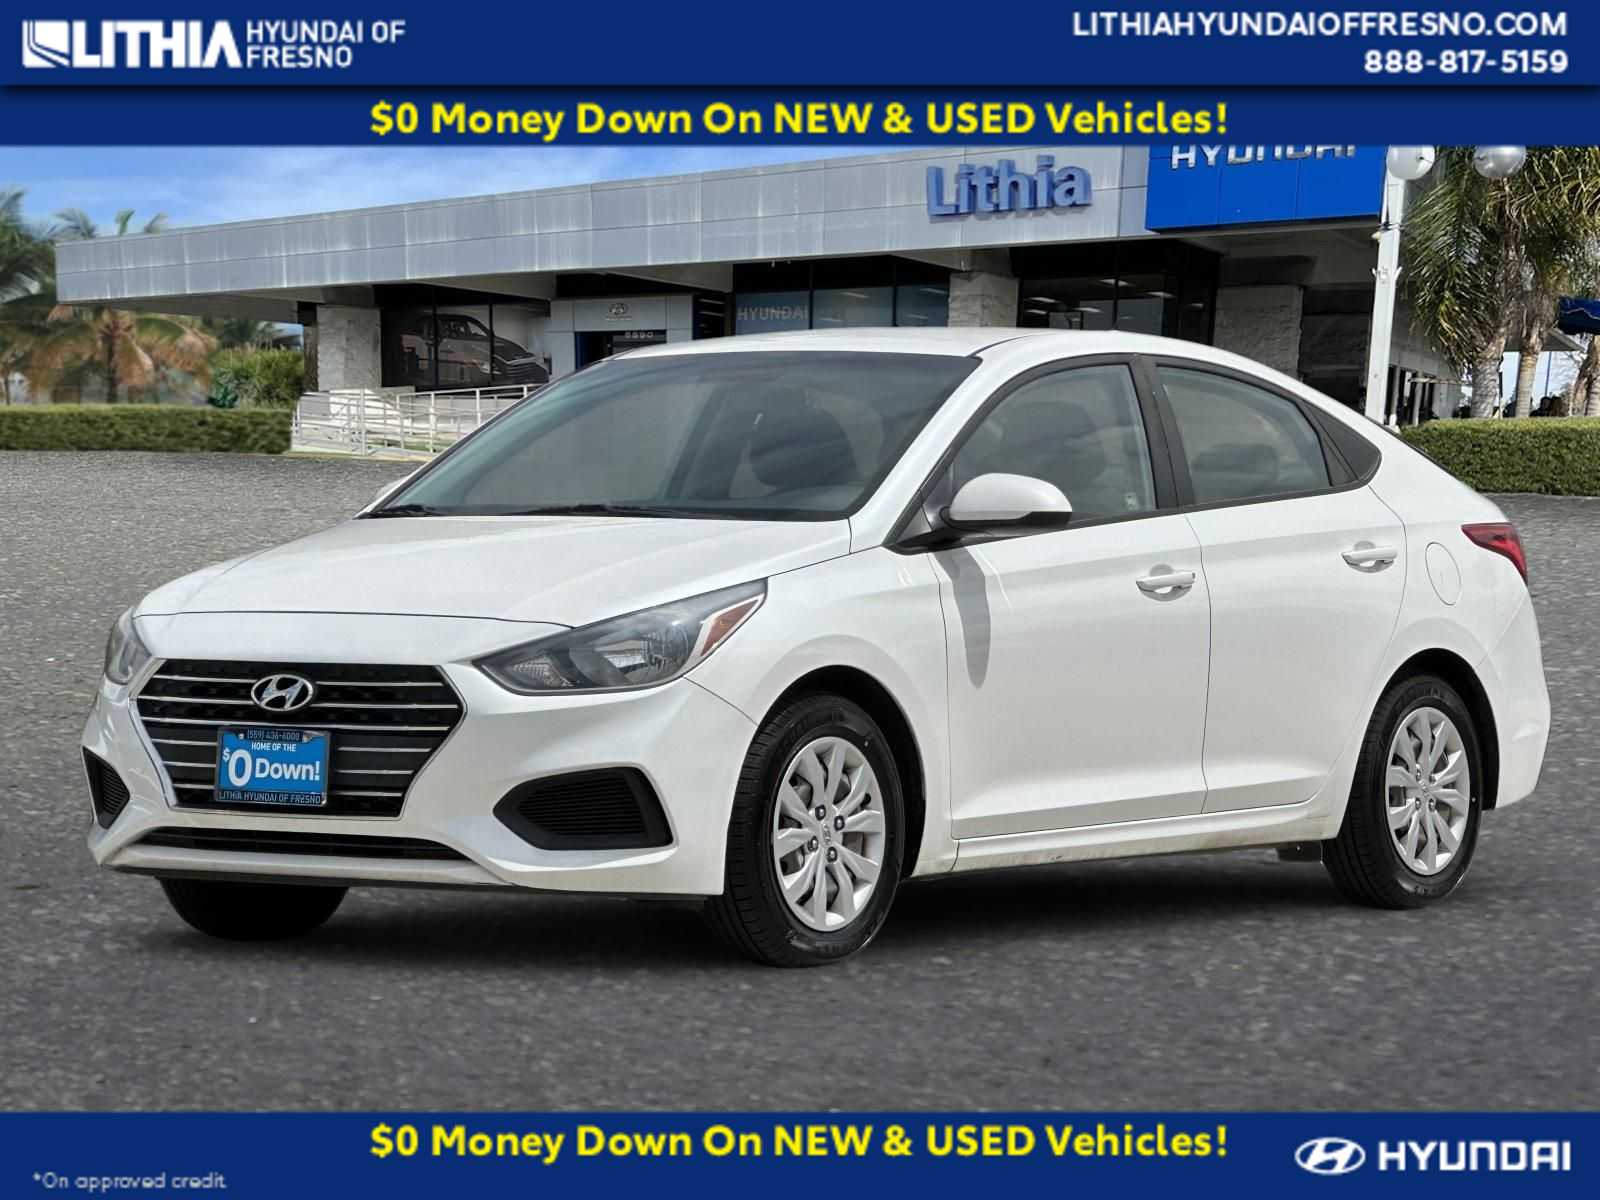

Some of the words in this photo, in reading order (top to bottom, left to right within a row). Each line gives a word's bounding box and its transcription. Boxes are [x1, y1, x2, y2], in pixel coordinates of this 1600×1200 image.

[926, 154, 1092, 216] Lithia
[736, 305, 809, 321] HYUNDAI
[251, 741, 271, 751] HOME
[271, 742, 282, 752] OF
[283, 743, 297, 752] THE
[255, 757, 321, 781] Down!
[218, 789, 242, 800] LITHIA
[243, 791, 278, 803] HYUNDAI
[279, 793, 289, 803] OF
[290, 793, 321, 805] FRESNO
